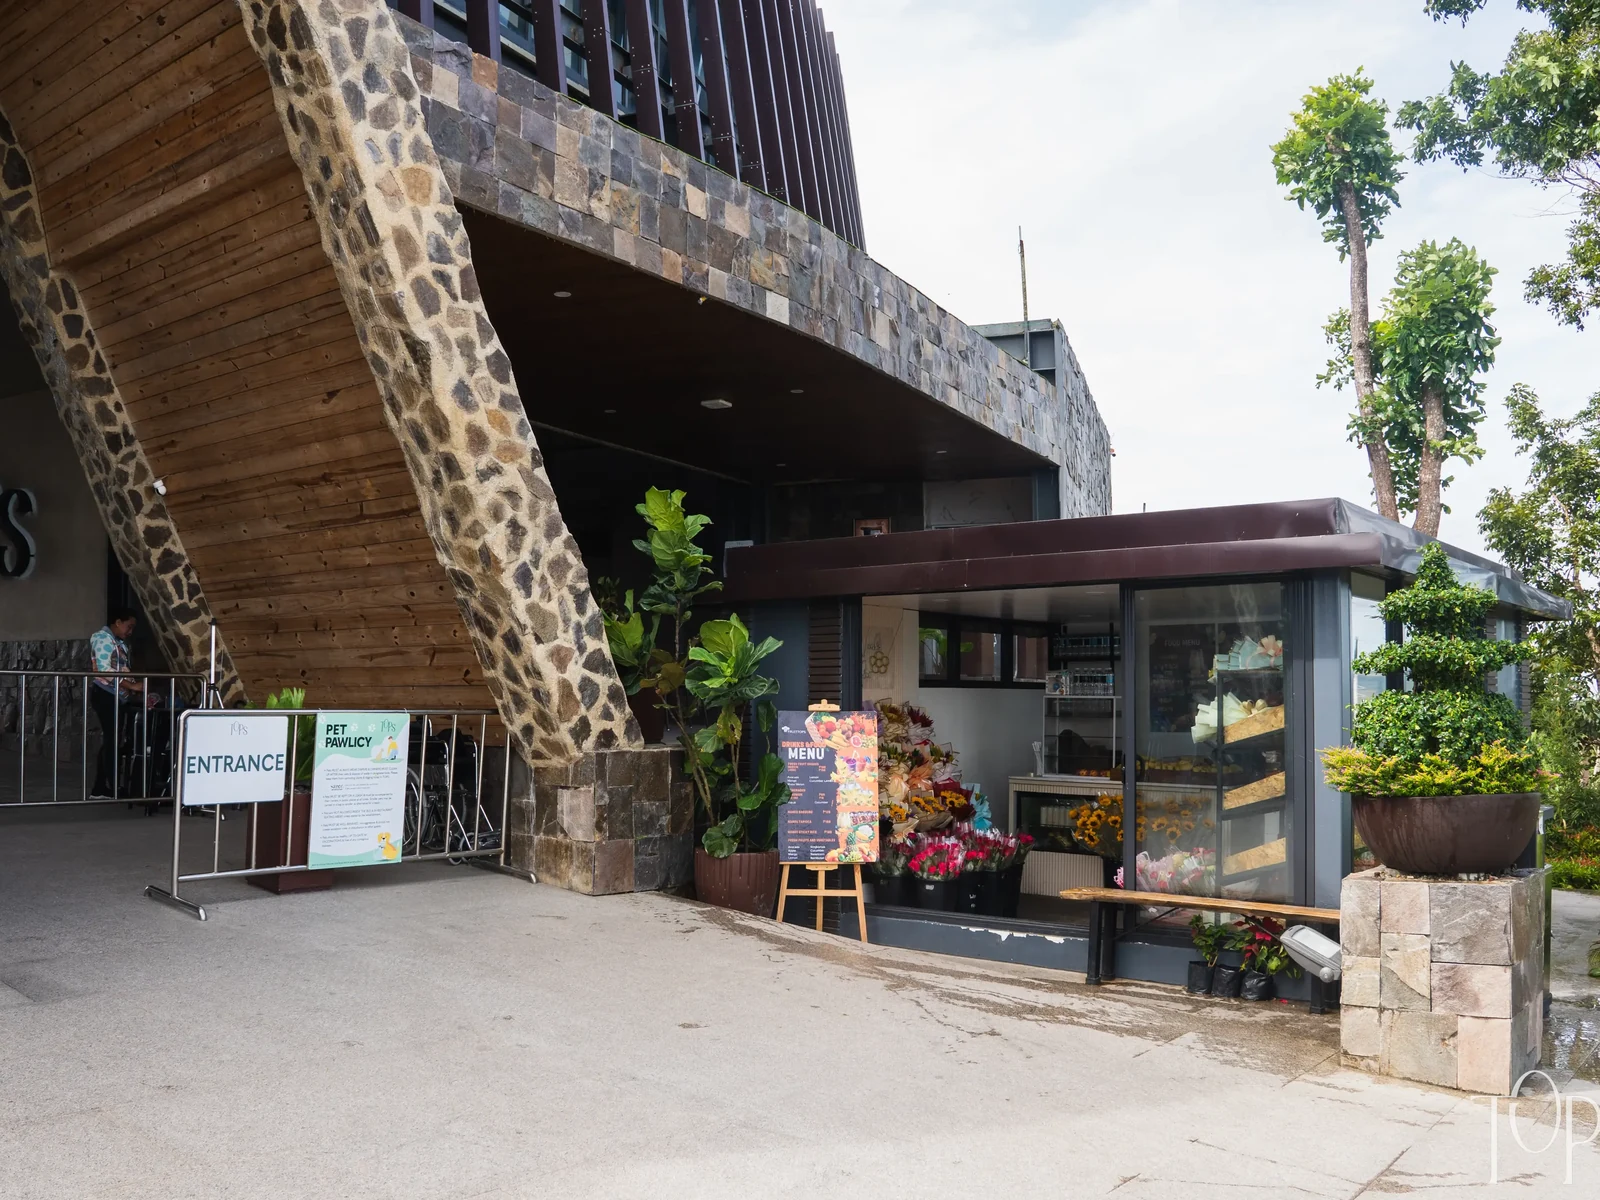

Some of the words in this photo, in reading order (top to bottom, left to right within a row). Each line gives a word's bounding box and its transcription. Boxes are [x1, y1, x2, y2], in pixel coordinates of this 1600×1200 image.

[1182, 638, 1201, 647] MENU
[326, 723, 348, 736] PET
[325, 736, 373, 748] PAWLICY
[788, 747, 825, 760] MENU
[187, 754, 285, 774] ENTRANCE
